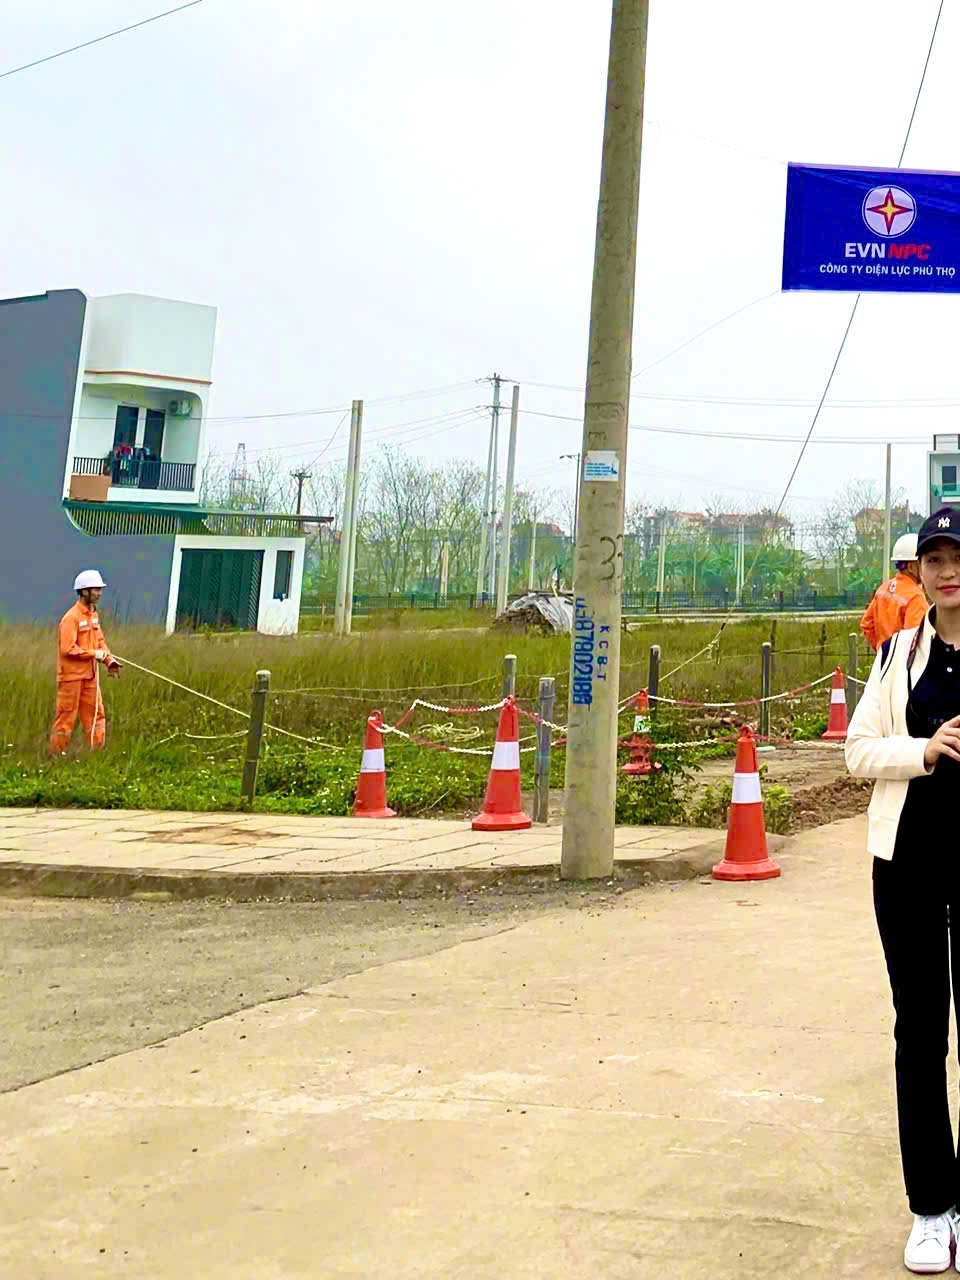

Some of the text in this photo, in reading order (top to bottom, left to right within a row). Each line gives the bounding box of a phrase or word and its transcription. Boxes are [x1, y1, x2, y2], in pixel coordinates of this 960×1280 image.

[819, 262, 848, 274] CÔNG
[850, 264, 864, 275] TY
[935, 266, 956, 279] THỌ
